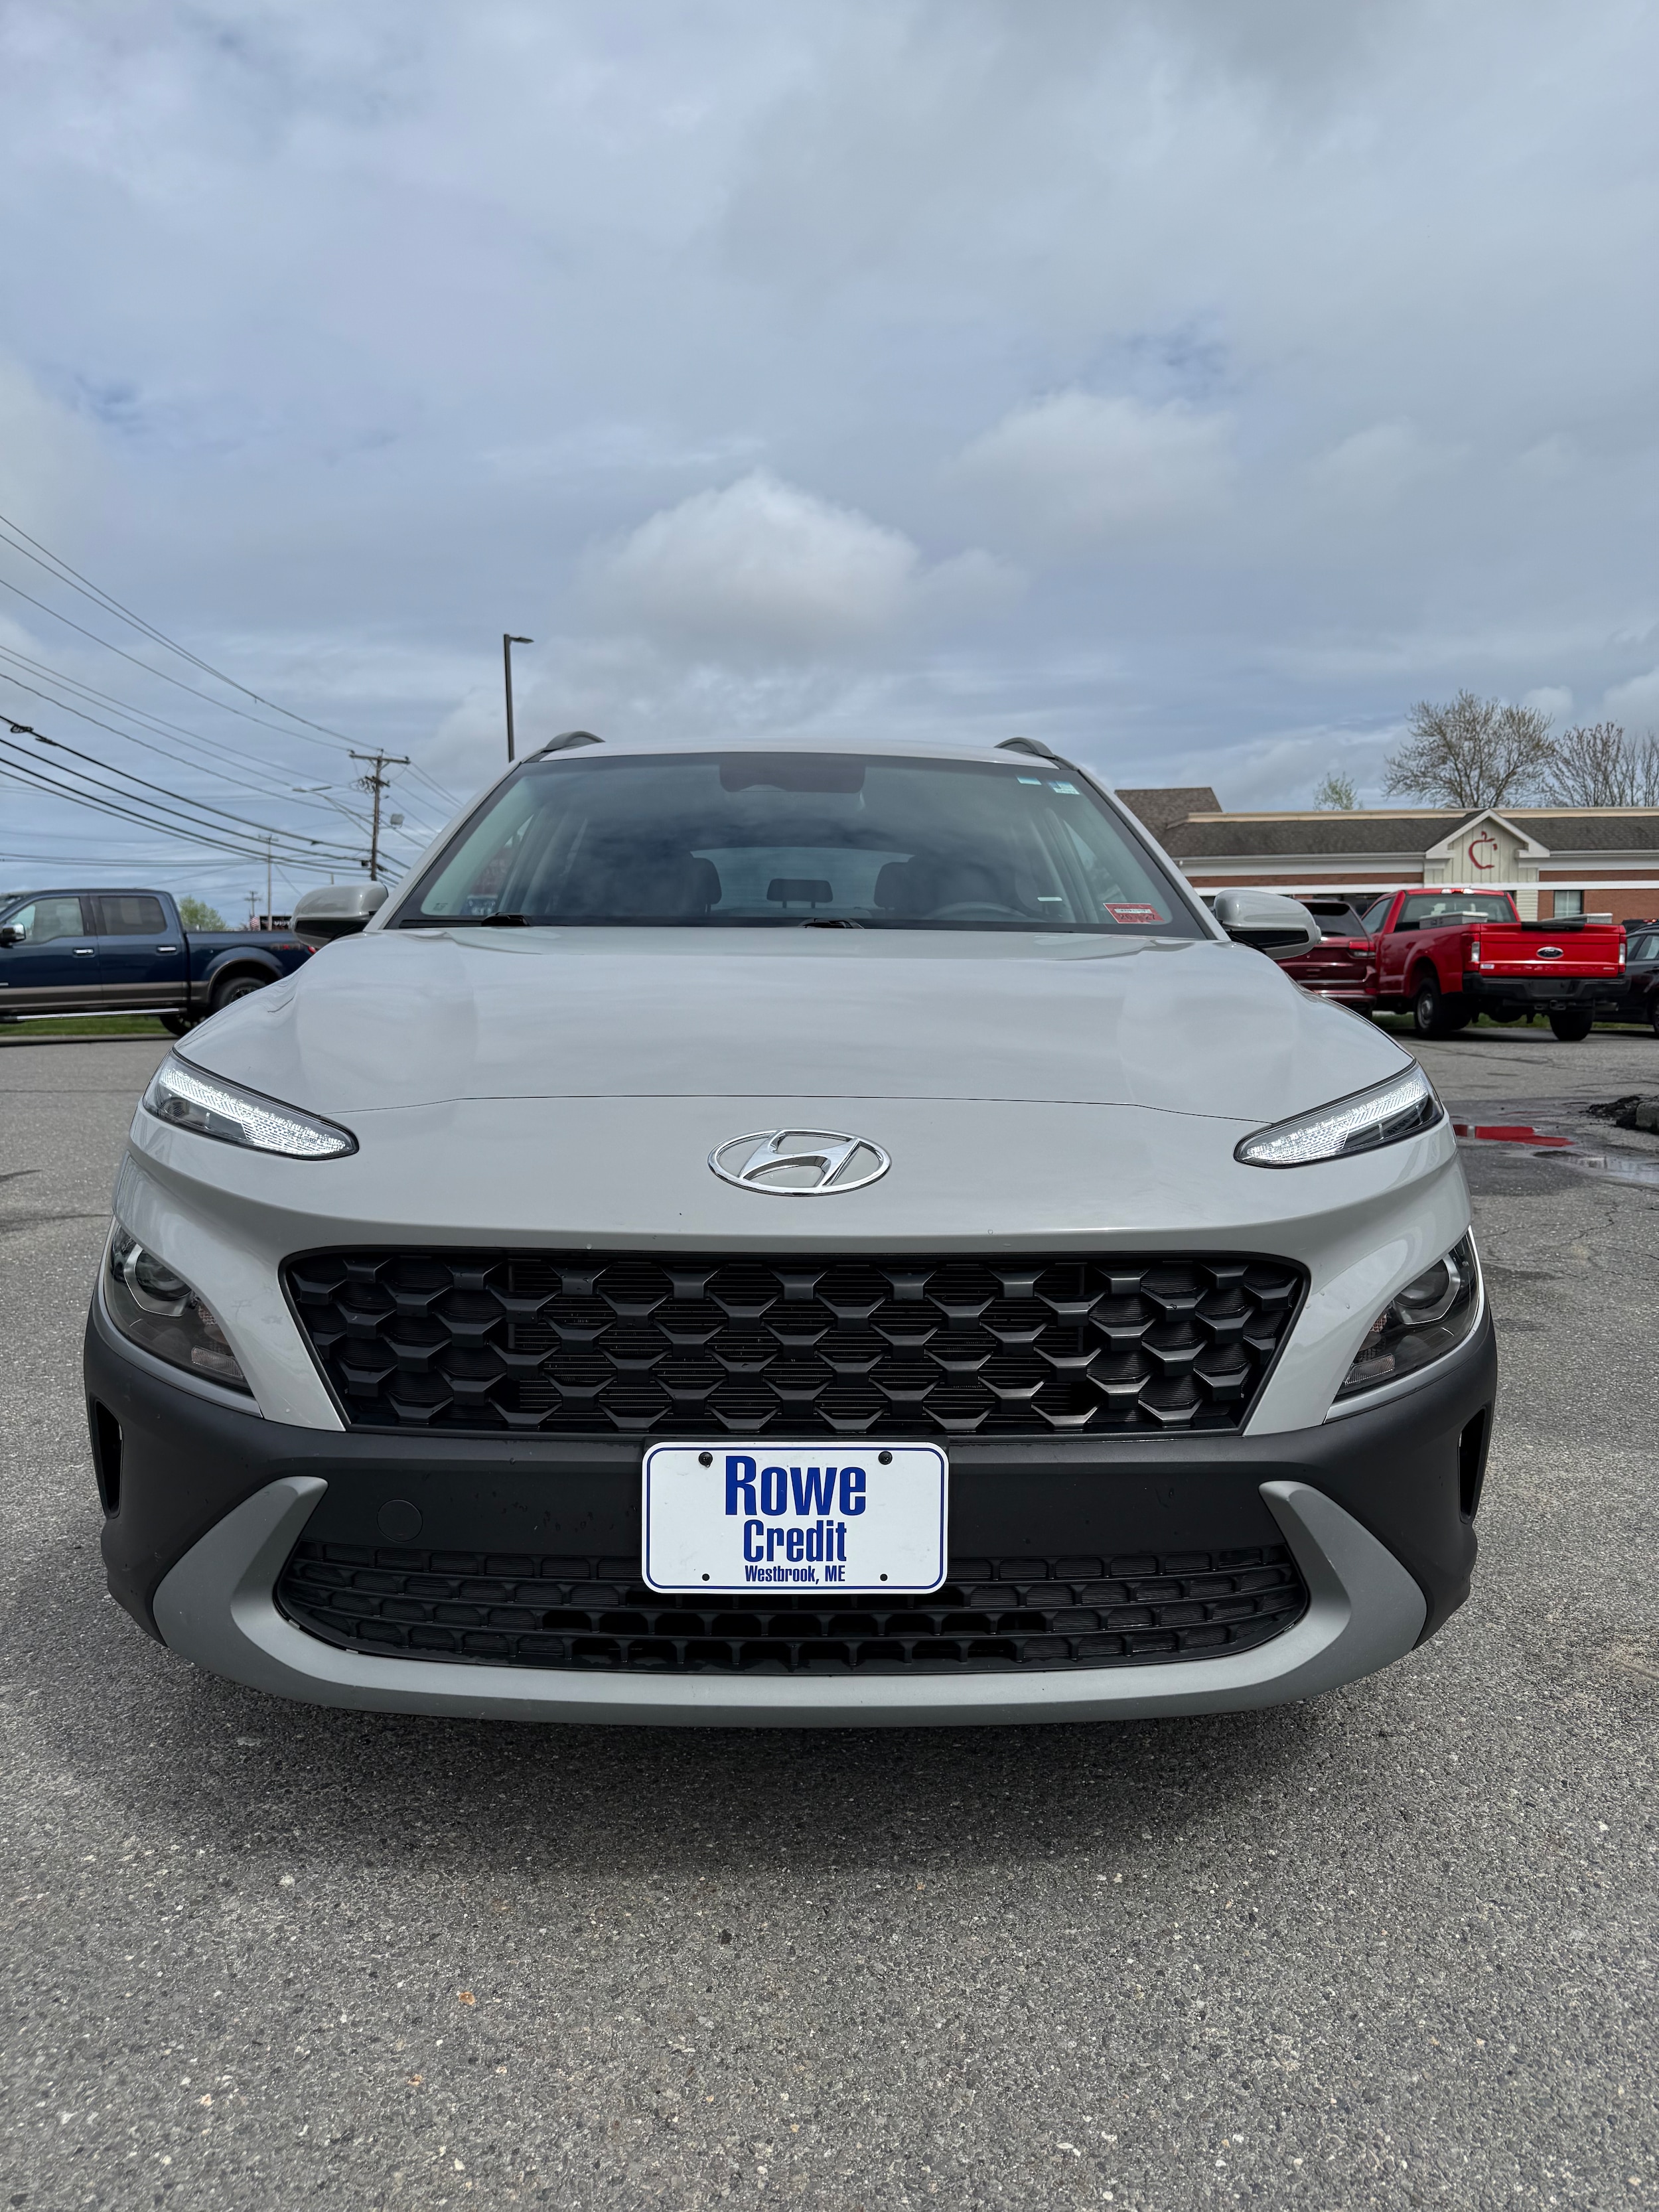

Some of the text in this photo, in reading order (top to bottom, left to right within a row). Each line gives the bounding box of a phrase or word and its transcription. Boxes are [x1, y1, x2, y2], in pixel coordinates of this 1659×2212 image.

[725, 1455, 866, 1516] Rowe
[743, 1520, 847, 1562] Credit
[745, 1566, 845, 1584] Westbrook, ME
